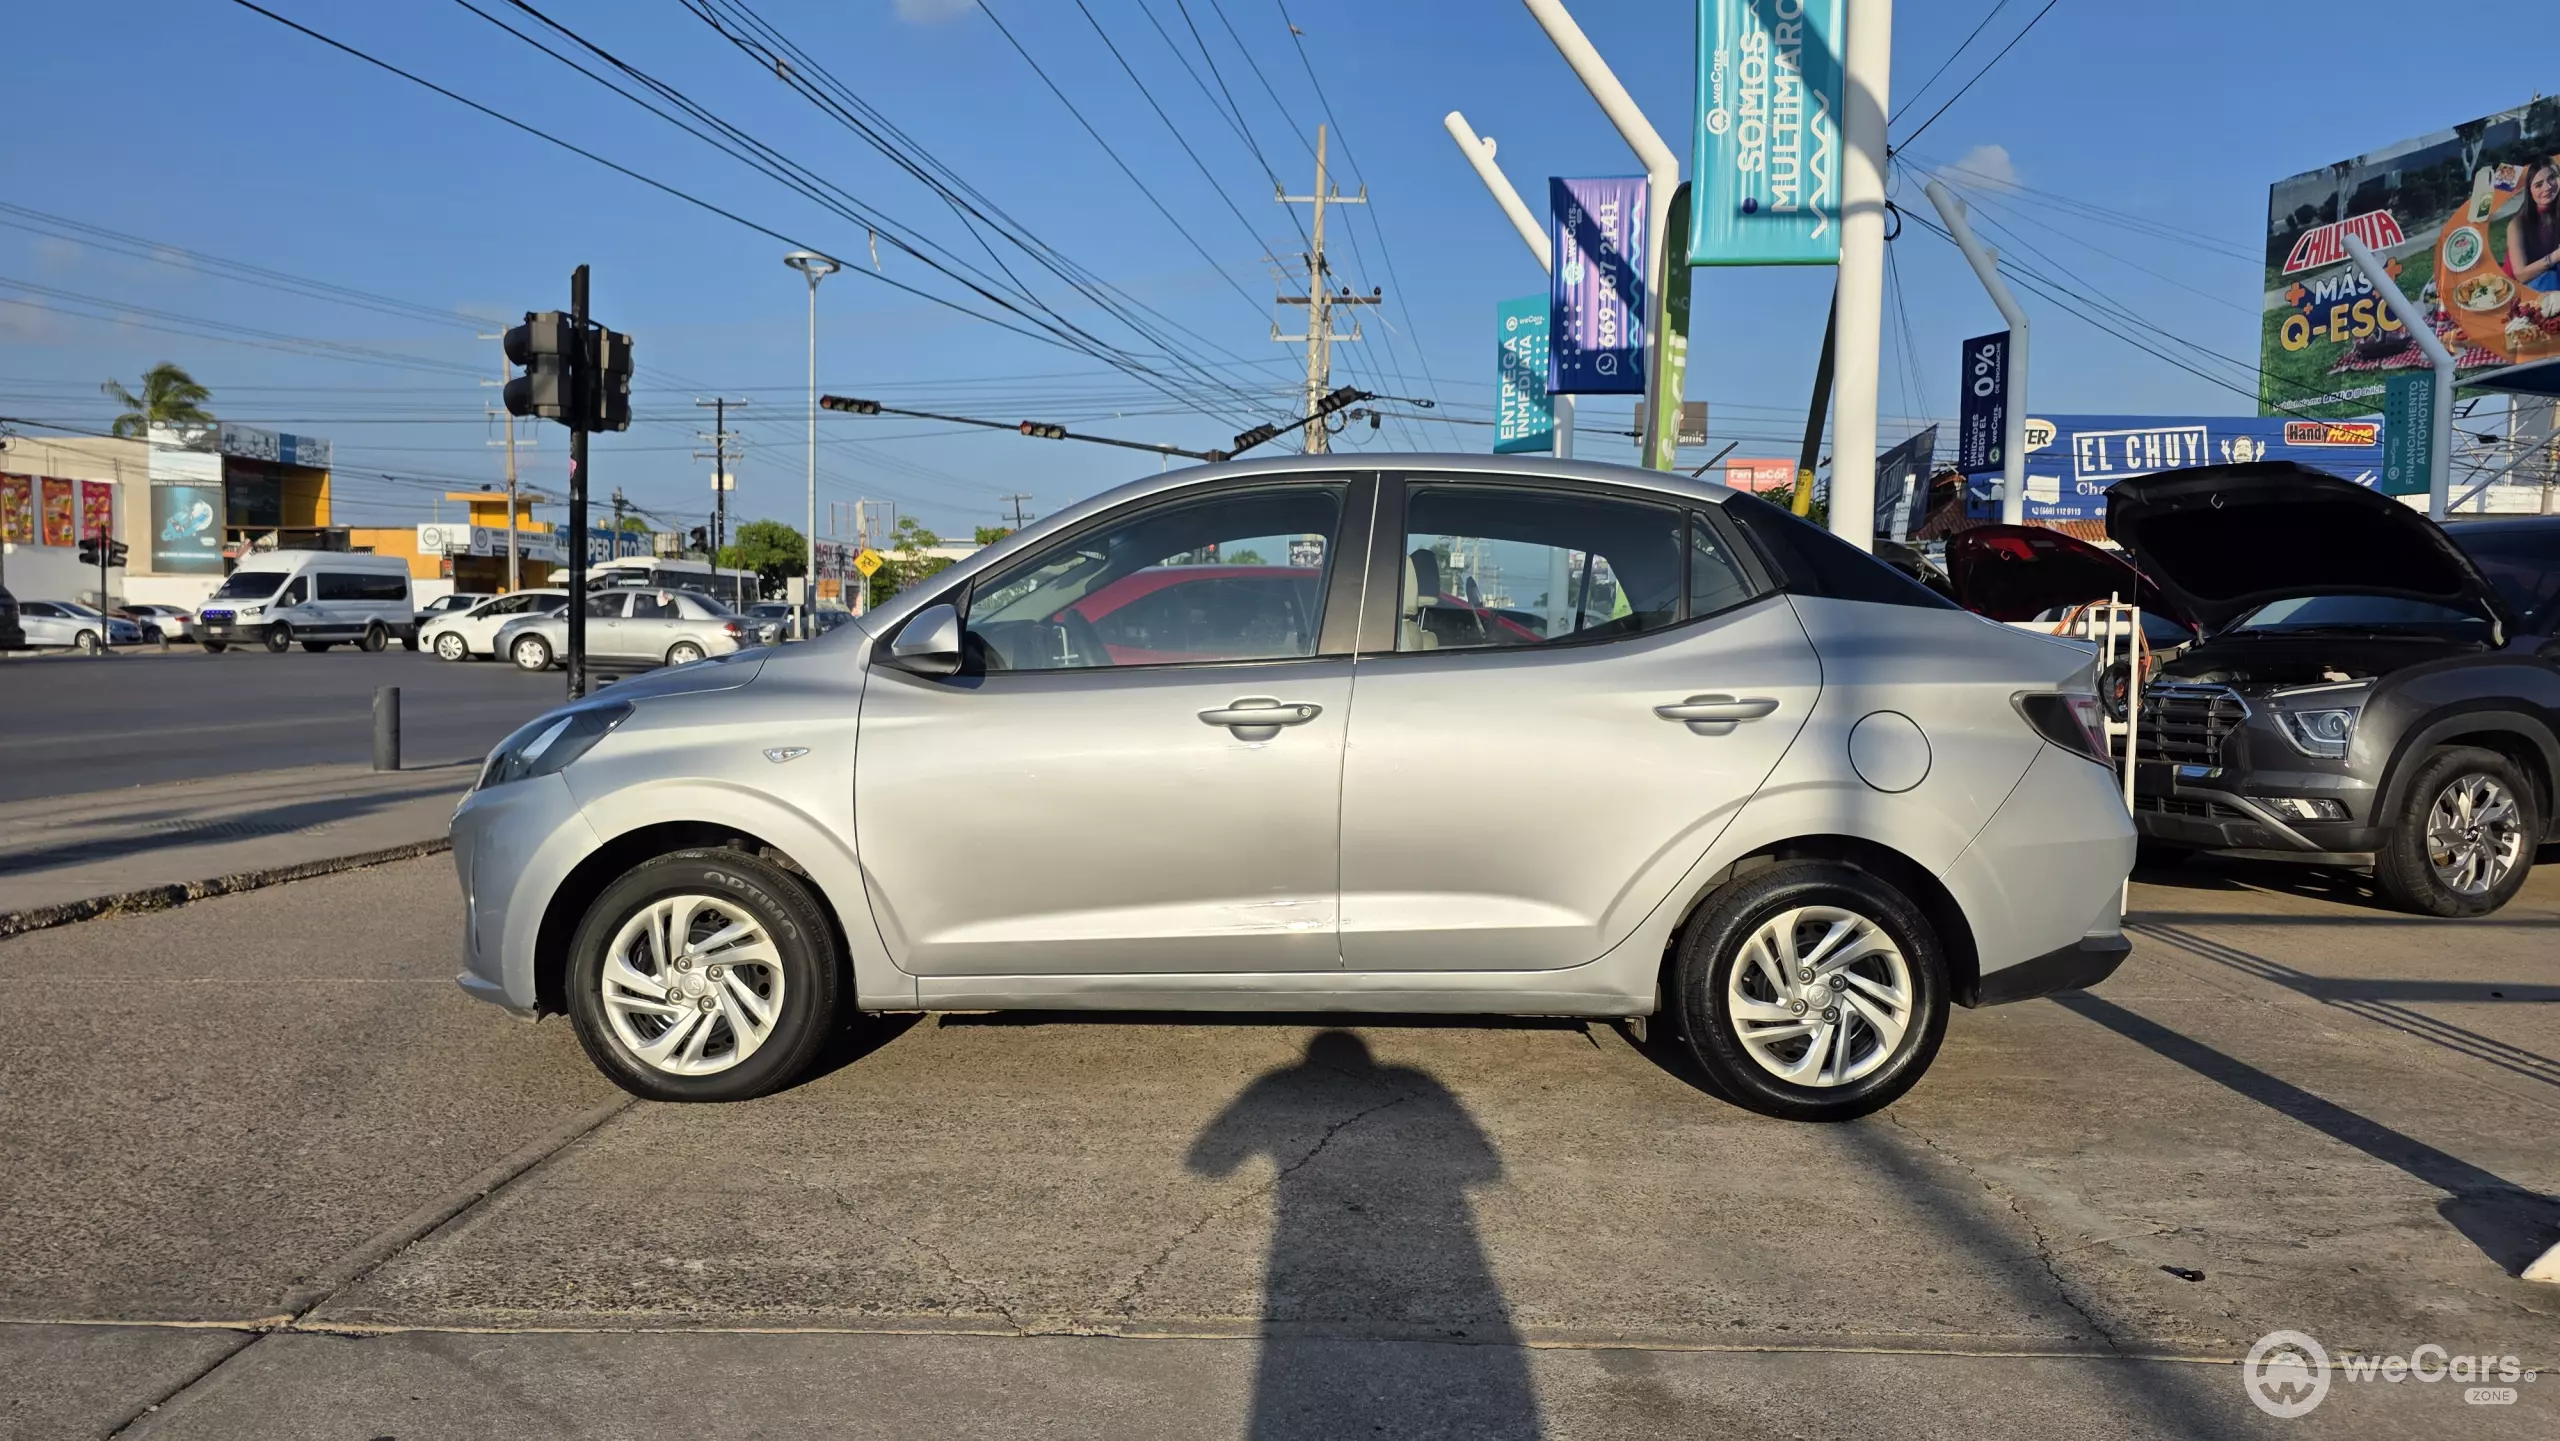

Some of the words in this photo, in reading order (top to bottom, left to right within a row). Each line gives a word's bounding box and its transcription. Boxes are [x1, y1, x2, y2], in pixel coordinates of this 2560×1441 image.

[1737, 31, 1767, 173] SOMOS
[1566, 206, 1578, 258] weCars
[1600, 199, 1619, 256] 2141
[1599, 262, 1618, 301] 267
[2315, 266, 2374, 305] MÁS
[1599, 307, 1617, 349] 669
[1500, 335, 1518, 440] ENTREGA
[1516, 334, 1533, 438] INMEDIATA
[1974, 343, 1996, 397] 0%
[1970, 413, 1979, 467] UNIDADES
[1977, 427, 1987, 466] DESDE
[1979, 415, 1987, 426] EL
[2025, 429, 2049, 445] ER
[2406, 381, 2419, 485] FINANCIAMIENTO
[2415, 379, 2430, 465] AUTOMOTRIZ
[2081, 438, 2113, 472] EL
[2125, 433, 2199, 470] CHUY
[2076, 482, 2107, 495] Cha
[703, 871, 797, 940] OPTIMO
